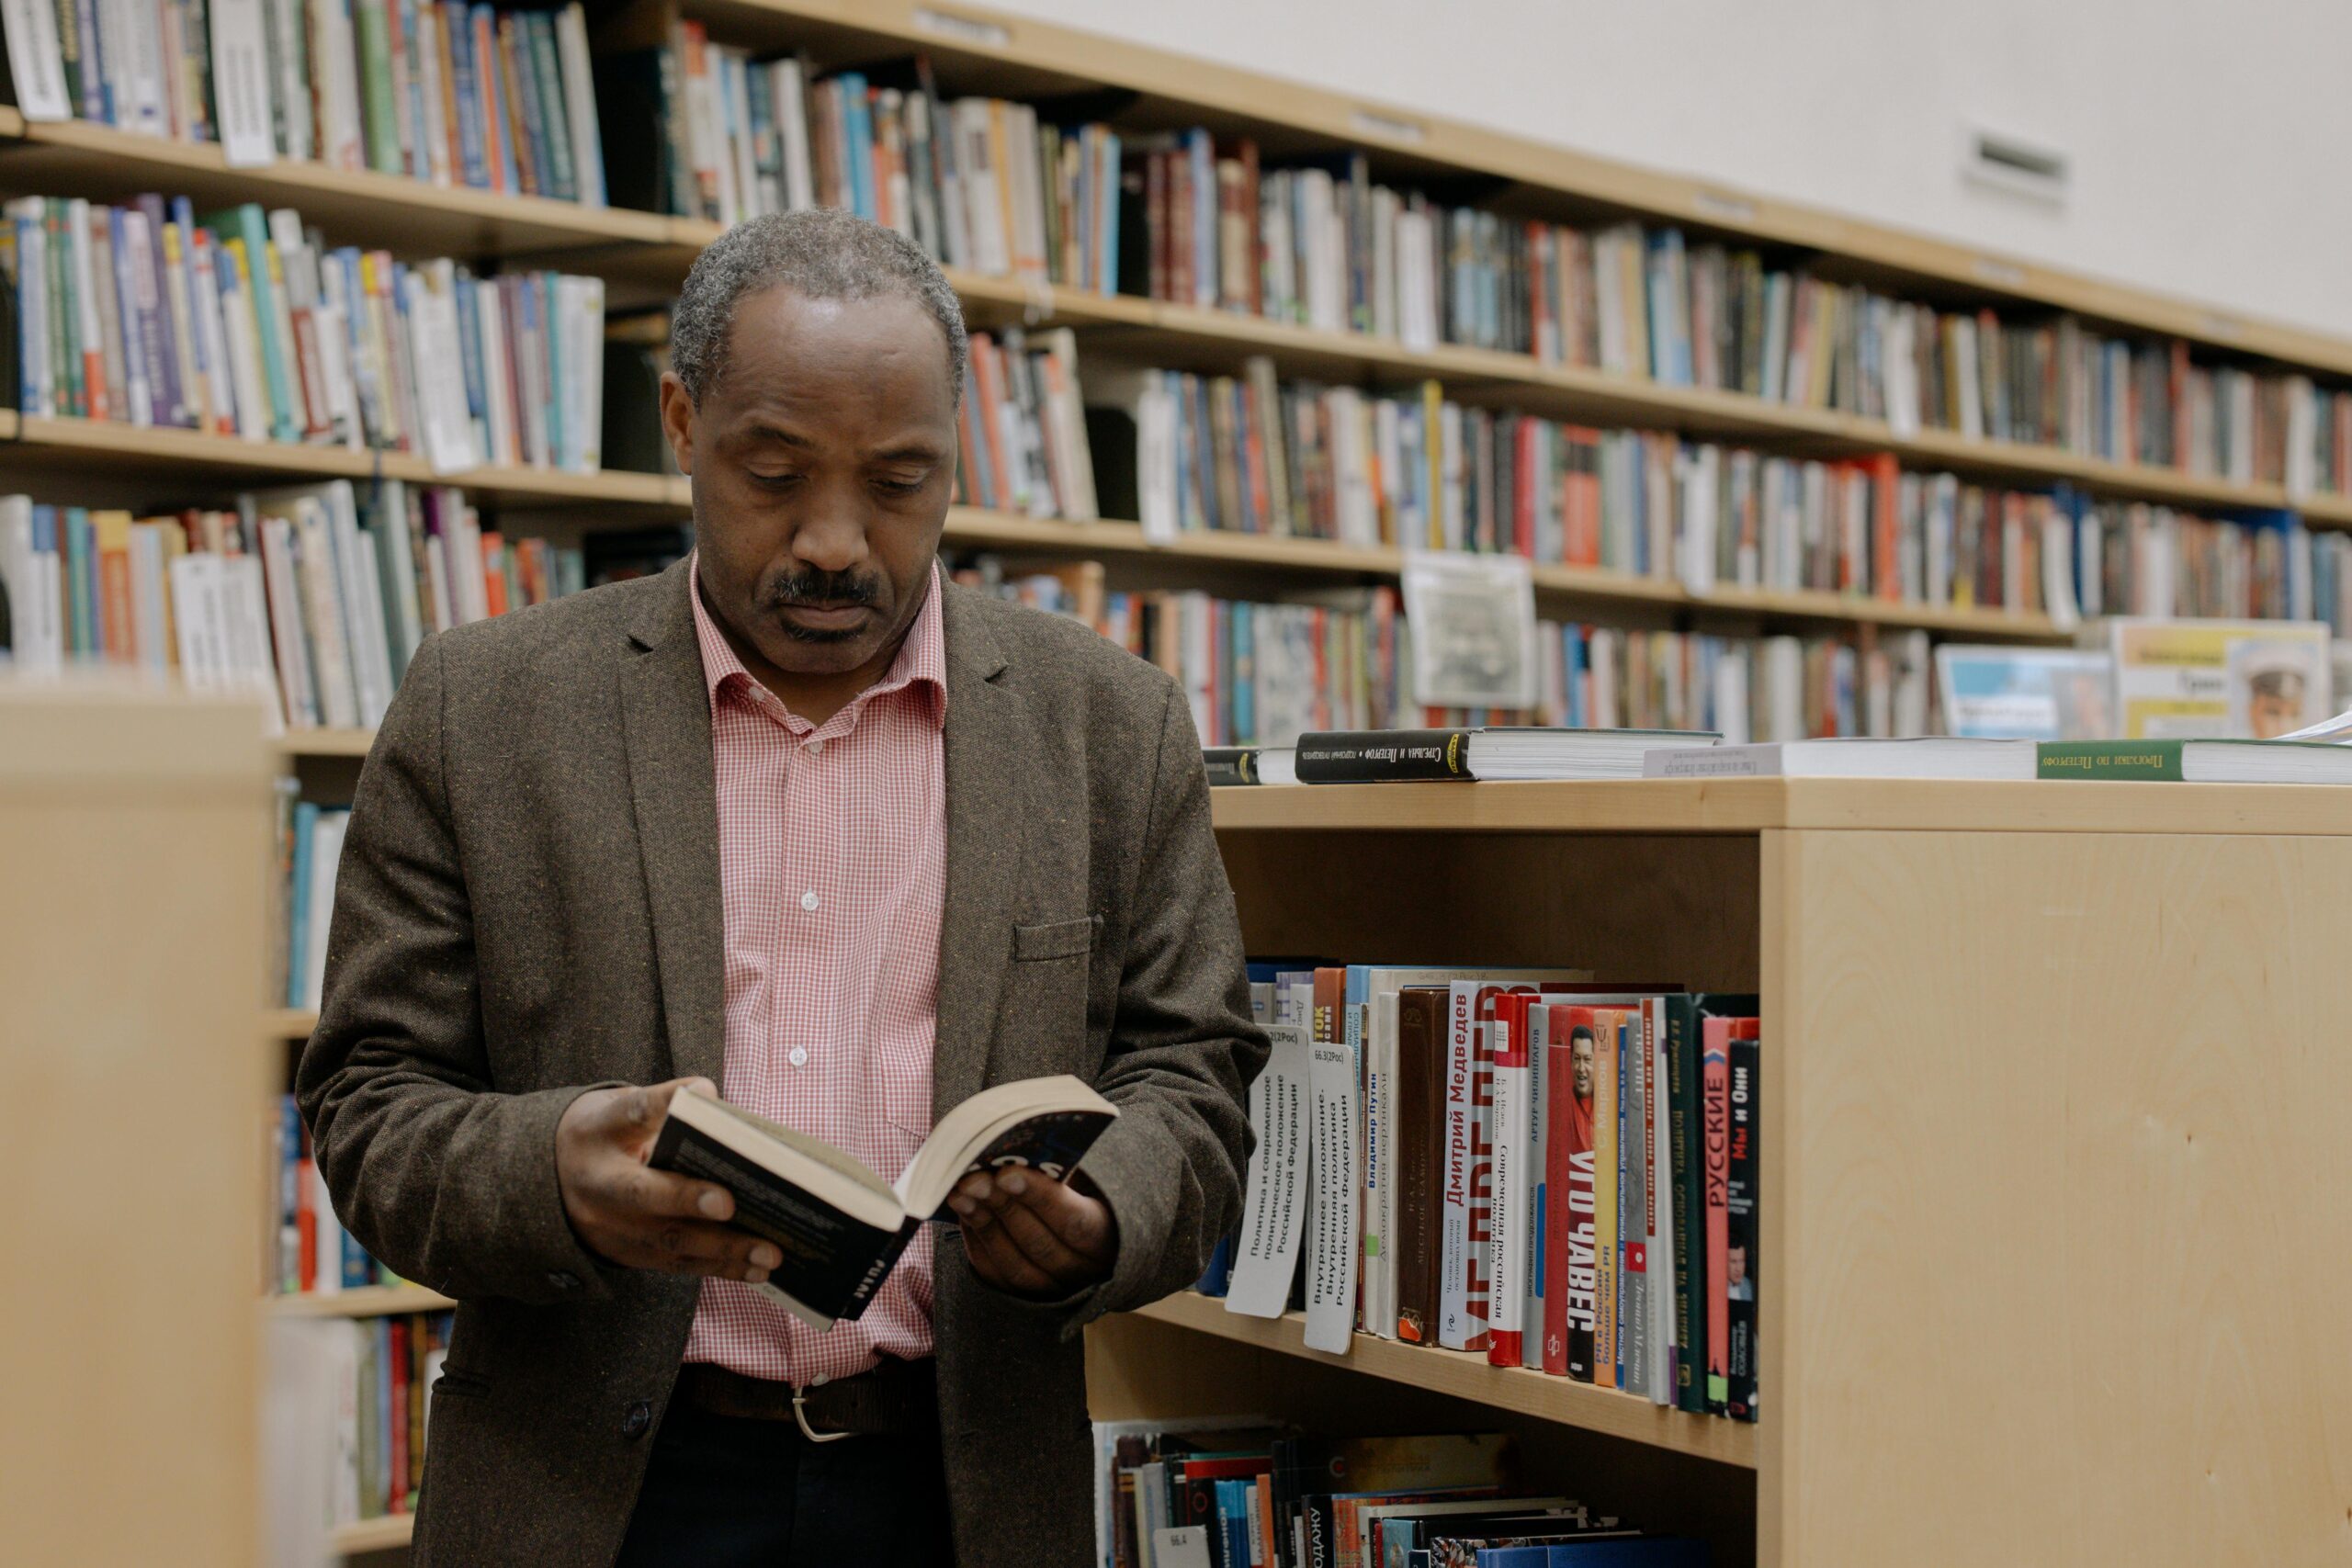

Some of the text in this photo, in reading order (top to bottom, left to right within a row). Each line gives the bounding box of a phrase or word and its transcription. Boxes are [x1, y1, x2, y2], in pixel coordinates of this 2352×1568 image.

[1270, 1032, 1298, 1045] 2(2Рос)
[1314, 1007, 1324, 1043] ТОК
[1446, 995, 1467, 1207] Дмитрий Медведев
[1250, 1076, 1273, 1257] Политика и современное
[1264, 1075, 1285, 1259] политическое положение
[1277, 1084, 1298, 1253] Российской Федерации
[1314, 1089, 1328, 1304] Внутреннее положение.
[1368, 1073, 1377, 1188] Владимир Путин
[1379, 1073, 1388, 1262] Демократия вертикали
[1707, 1077, 1724, 1208] РУССКИЕ
[1732, 1066, 1747, 1160] Мы и Они
[1326, 1102, 1339, 1295] Внутренняя политика
[1336, 1095, 1350, 1306] Российской Федерации
[1495, 1145, 1508, 1318] Современная российская
[1567, 1150, 1595, 1331] УГО ЧАВЕС
[1675, 1183, 1687, 1265] ОСНОВАННАЯ
[1676, 1271, 1687, 1286] НА
[1634, 1279, 1645, 1384] Леонид Млечин
[1676, 1293, 1688, 1349] ЗНАНИЯХ
